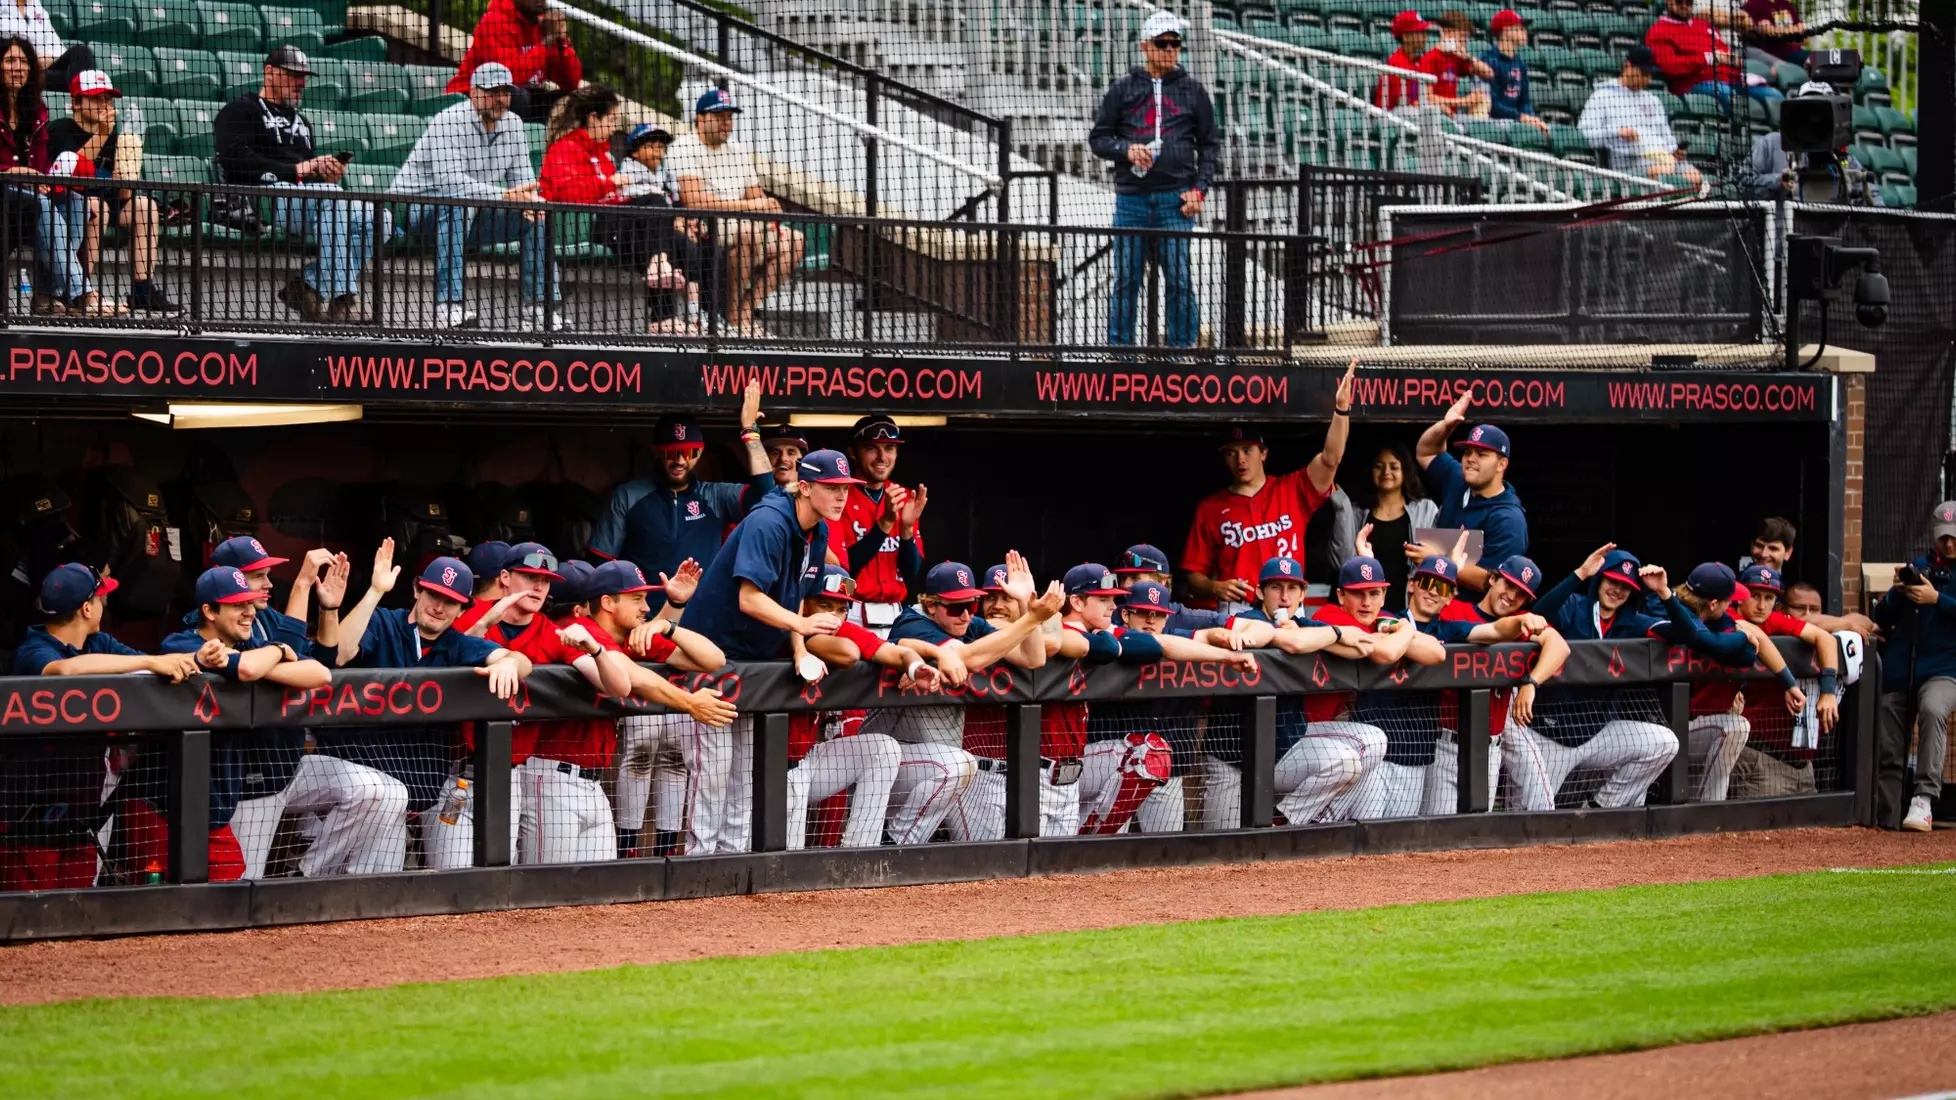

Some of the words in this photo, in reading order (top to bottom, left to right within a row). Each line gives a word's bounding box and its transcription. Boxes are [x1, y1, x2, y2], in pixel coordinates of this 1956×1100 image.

[328, 356, 641, 393] WWW.PRASCO.COM
[702, 364, 982, 399] WWW.PRASCO.COM
[1035, 372, 1288, 404] WWW.PRASCO.COM
[1609, 383, 1814, 411] WWW.PRASCO.COM
[1137, 659, 1262, 691] PRASCO
[1453, 650, 1566, 680] PRASC
[877, 666, 1014, 698] PCO
[2, 688, 121, 726] ASCO
[281, 680, 443, 717] PRASCO
